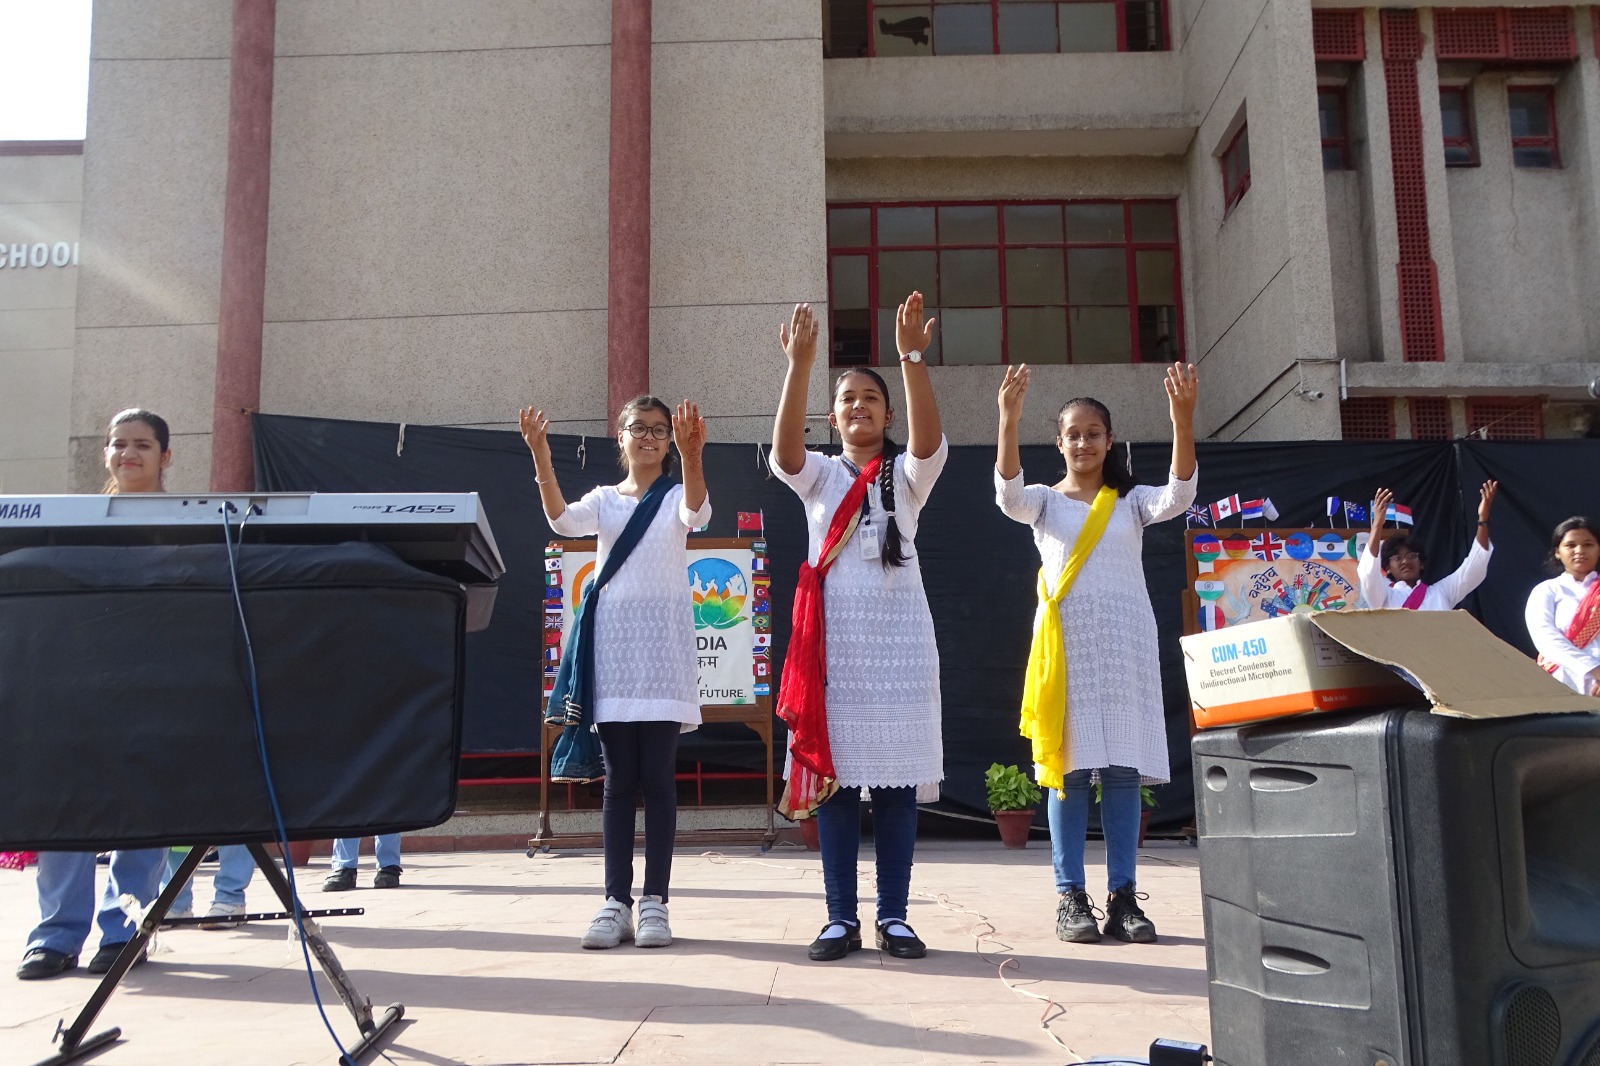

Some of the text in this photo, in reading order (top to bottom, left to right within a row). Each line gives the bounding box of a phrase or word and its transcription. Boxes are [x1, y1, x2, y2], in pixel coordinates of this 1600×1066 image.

[696, 636, 728, 651] DIA
[1211, 637, 1267, 663] CUM-450
[1209, 660, 1276, 678] Electret Condenser
[1199, 668, 1293, 690] Unidirectional Microphone
[699, 689, 747, 698] FUTURE.
